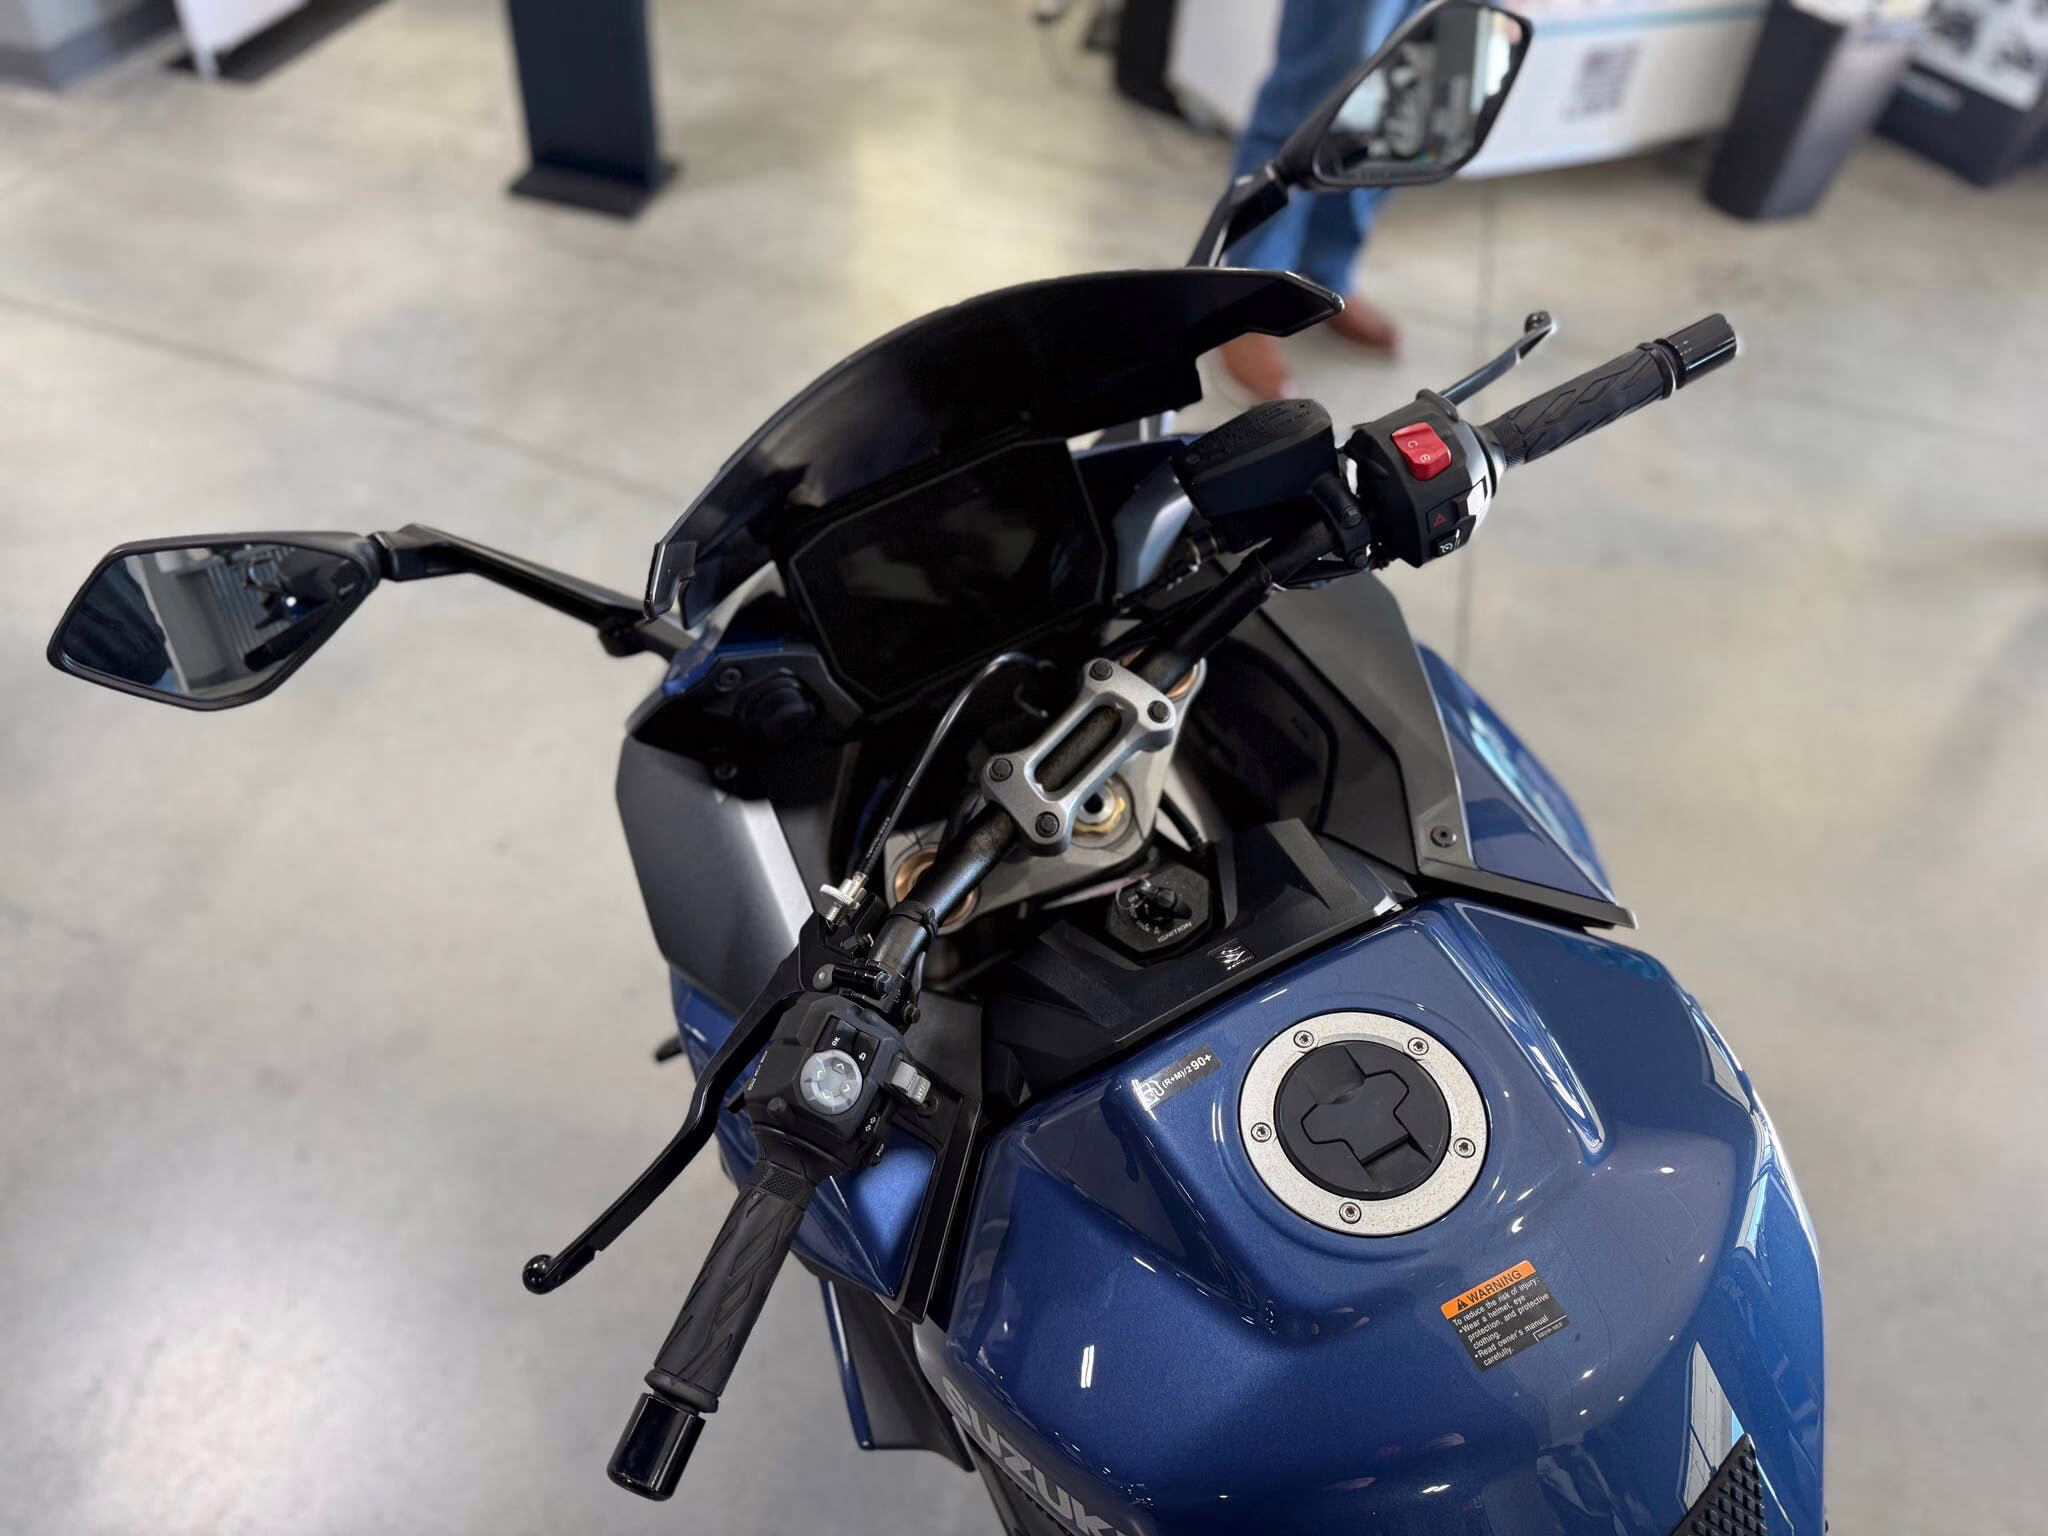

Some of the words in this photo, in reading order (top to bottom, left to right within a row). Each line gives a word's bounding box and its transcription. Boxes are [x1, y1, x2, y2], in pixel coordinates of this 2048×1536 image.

[1157, 921, 1192, 943] IGNITION
[831, 1036, 840, 1047] OK
[1190, 1054, 1212, 1071] 90+
[1453, 1318, 1463, 1327] To
[1463, 1307, 1486, 1324] reduce
[1486, 1298, 1497, 1311] the
[1498, 1292, 1511, 1304] risk
[1511, 1287, 1519, 1297] of
[1519, 1277, 1540, 1294] injury:
[1468, 1269, 1522, 1304] WARNING
[1462, 1319, 1481, 1333] Wear
[1488, 1303, 1514, 1320] helmet,
[1513, 1295, 1526, 1307] eye
[1467, 1319, 1504, 1342] protection,
[1504, 1310, 1518, 1322] and
[1518, 1293, 1550, 1315] protective
[1473, 1330, 1502, 1350] clothing.
[1478, 1343, 1497, 1358] Read
[1497, 1330, 1524, 1347] owner's
[1524, 1314, 1549, 1332] manual
[1483, 1347, 1514, 1367] carefully.
[942, 1376, 1127, 1536] SUZUK
